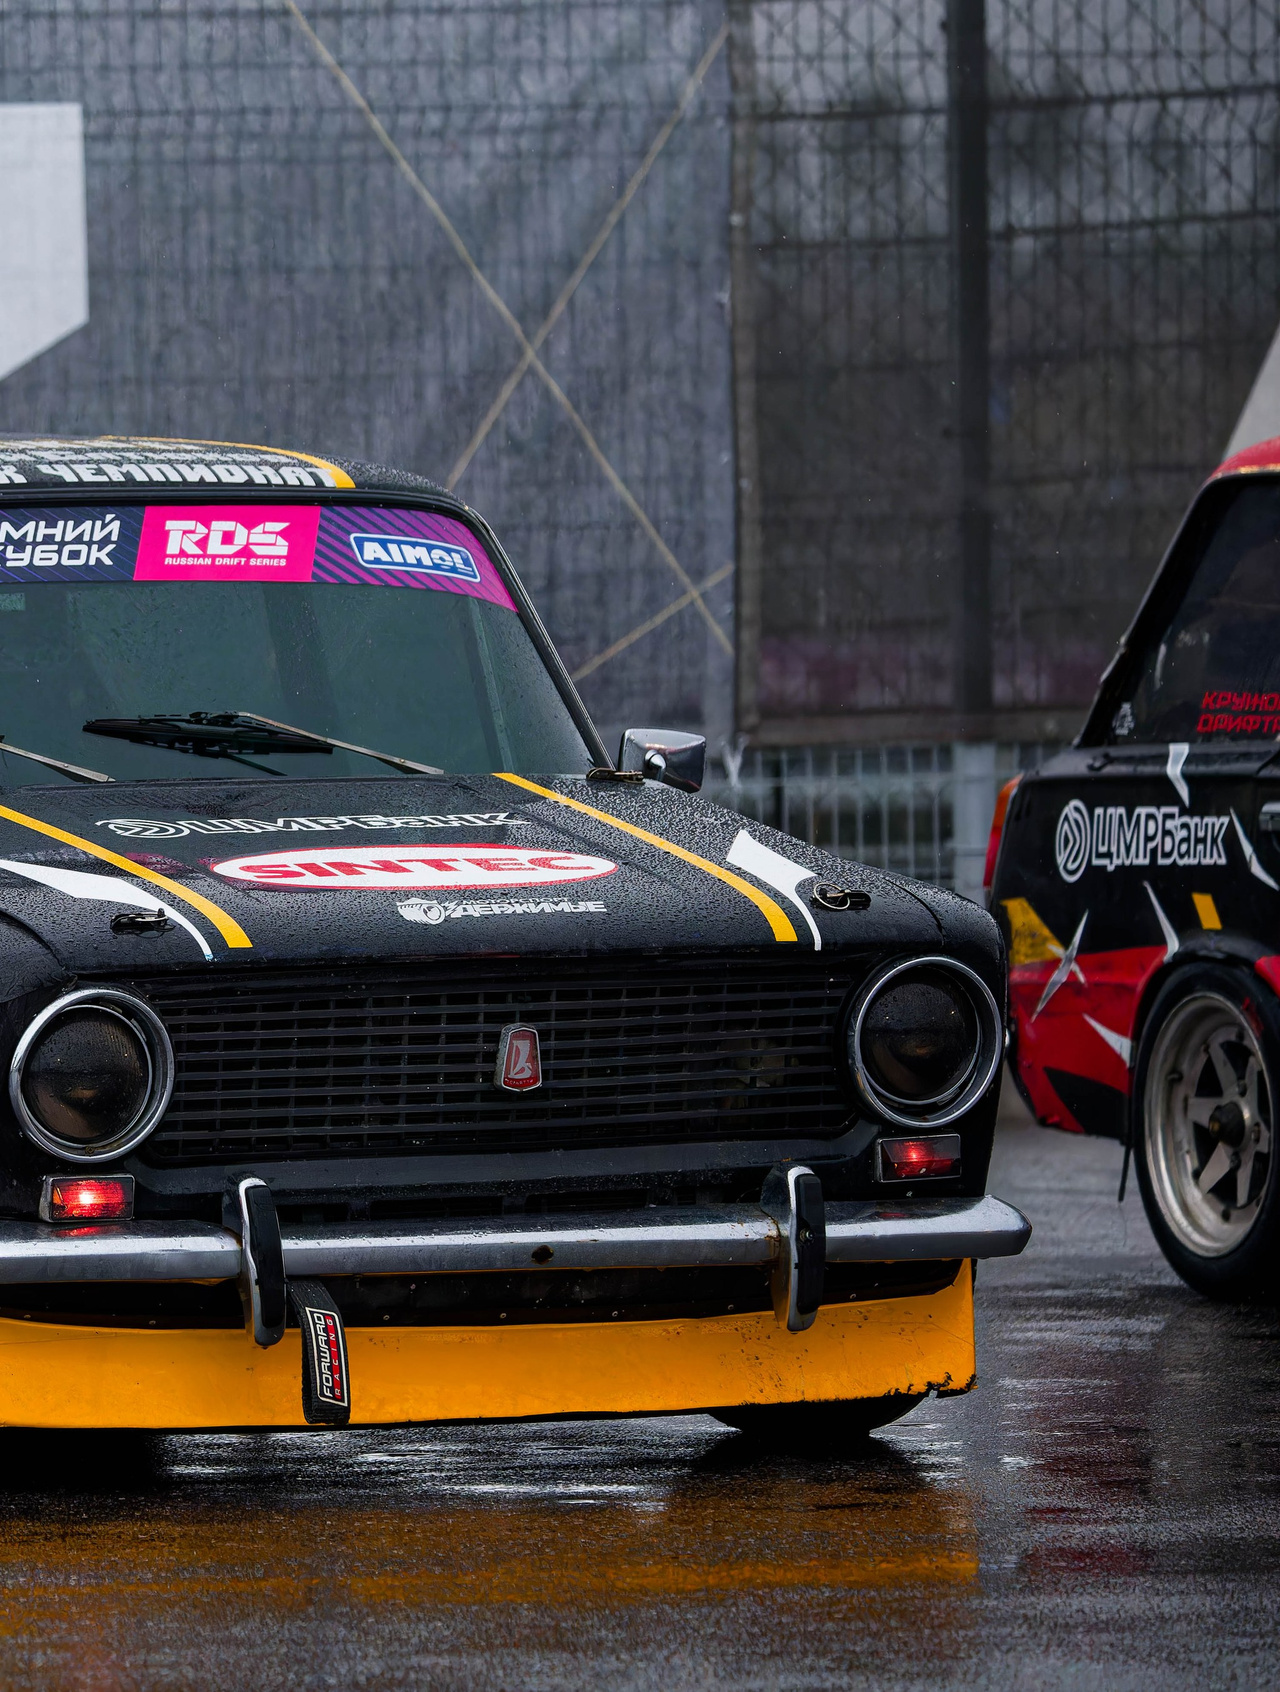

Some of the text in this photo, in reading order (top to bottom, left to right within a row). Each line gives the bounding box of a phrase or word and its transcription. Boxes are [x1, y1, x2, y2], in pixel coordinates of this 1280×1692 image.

[36, 463, 337, 488] ЧЕМПИОНАТ
[165, 520, 291, 556] RDS
[164, 557, 286, 566] RUSSIAN DRIFT SERIES
[362, 541, 473, 574] AIMOL
[1202, 691, 1280, 711] КРУЖО
[238, 856, 594, 880] SINTEC
[450, 901, 608, 918] ДЕРЖИМЫЕ
[314, 1313, 333, 1397] FORWARD
[326, 1318, 341, 1396] RACING
